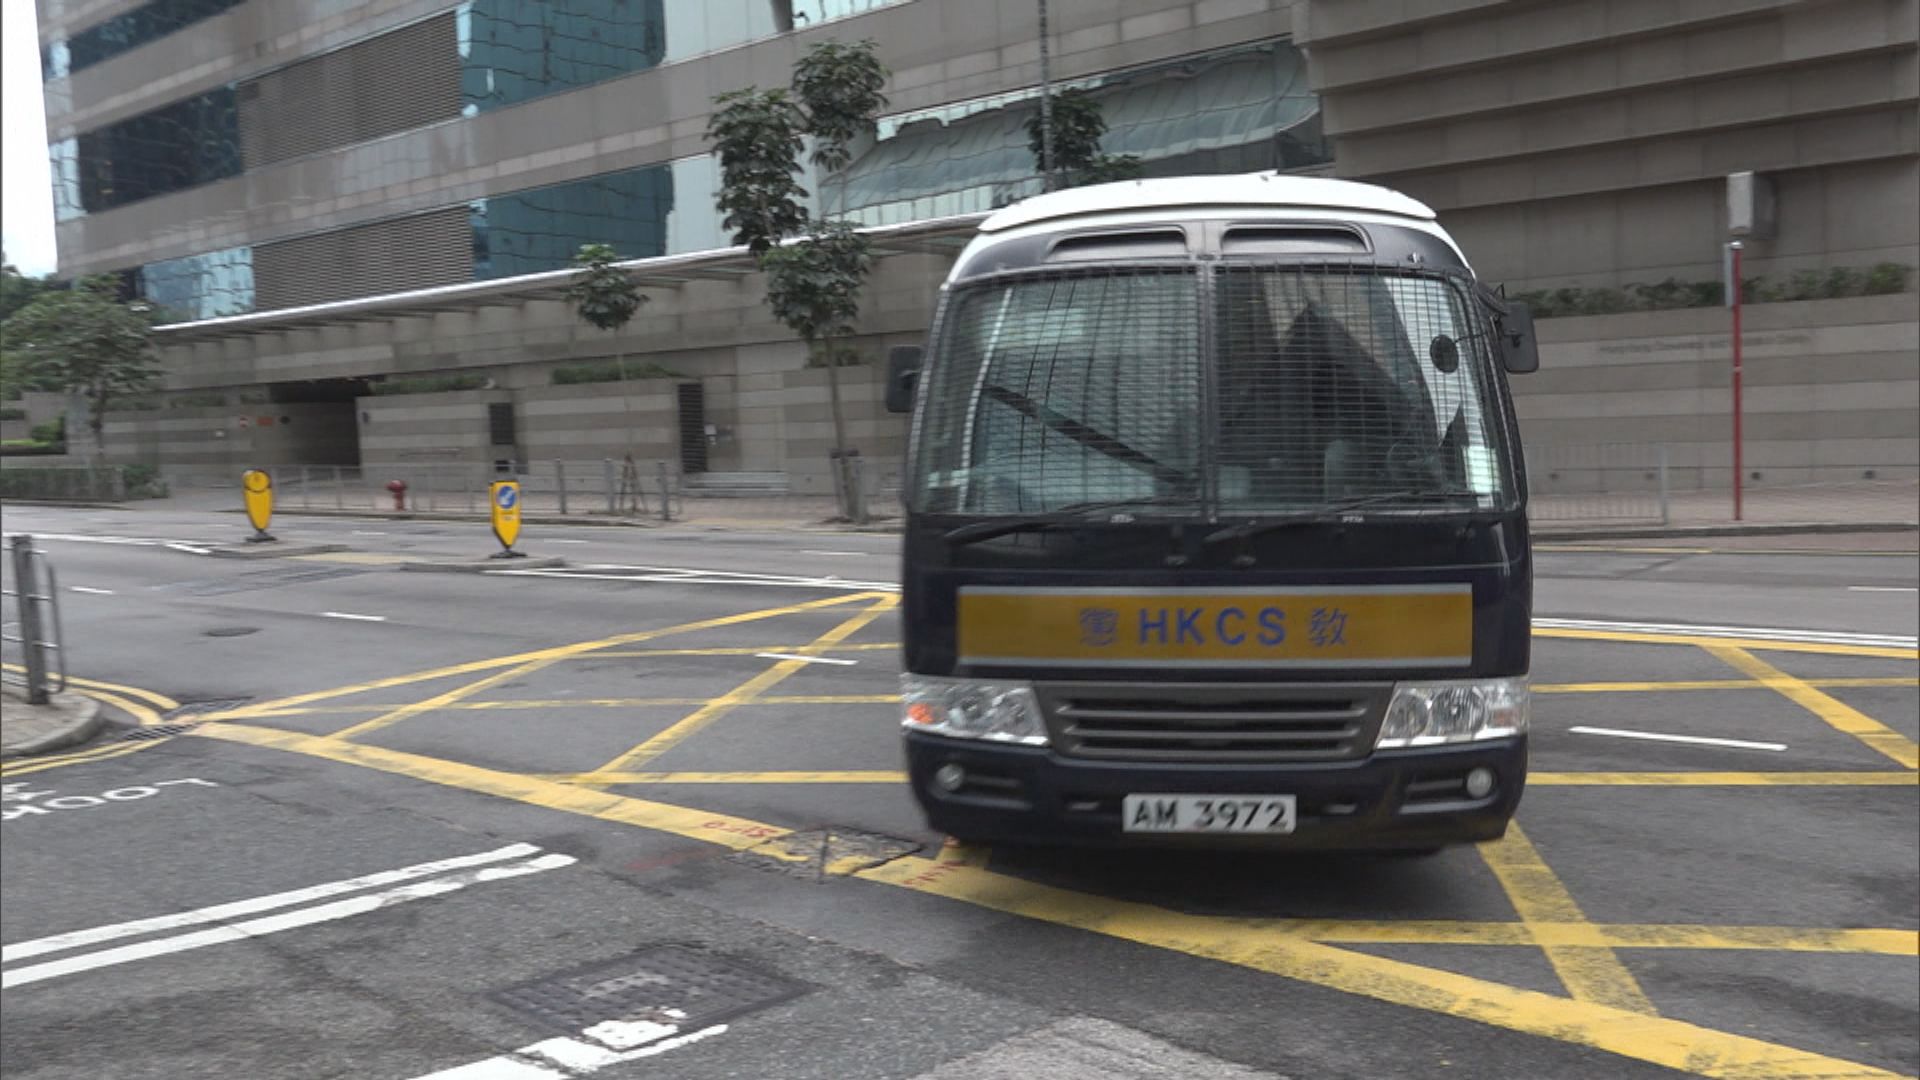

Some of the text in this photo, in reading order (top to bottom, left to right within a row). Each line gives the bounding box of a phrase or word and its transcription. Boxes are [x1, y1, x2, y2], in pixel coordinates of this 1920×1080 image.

[1138, 606, 1287, 646] HKCS
[1132, 798, 1289, 831] AM 3972
